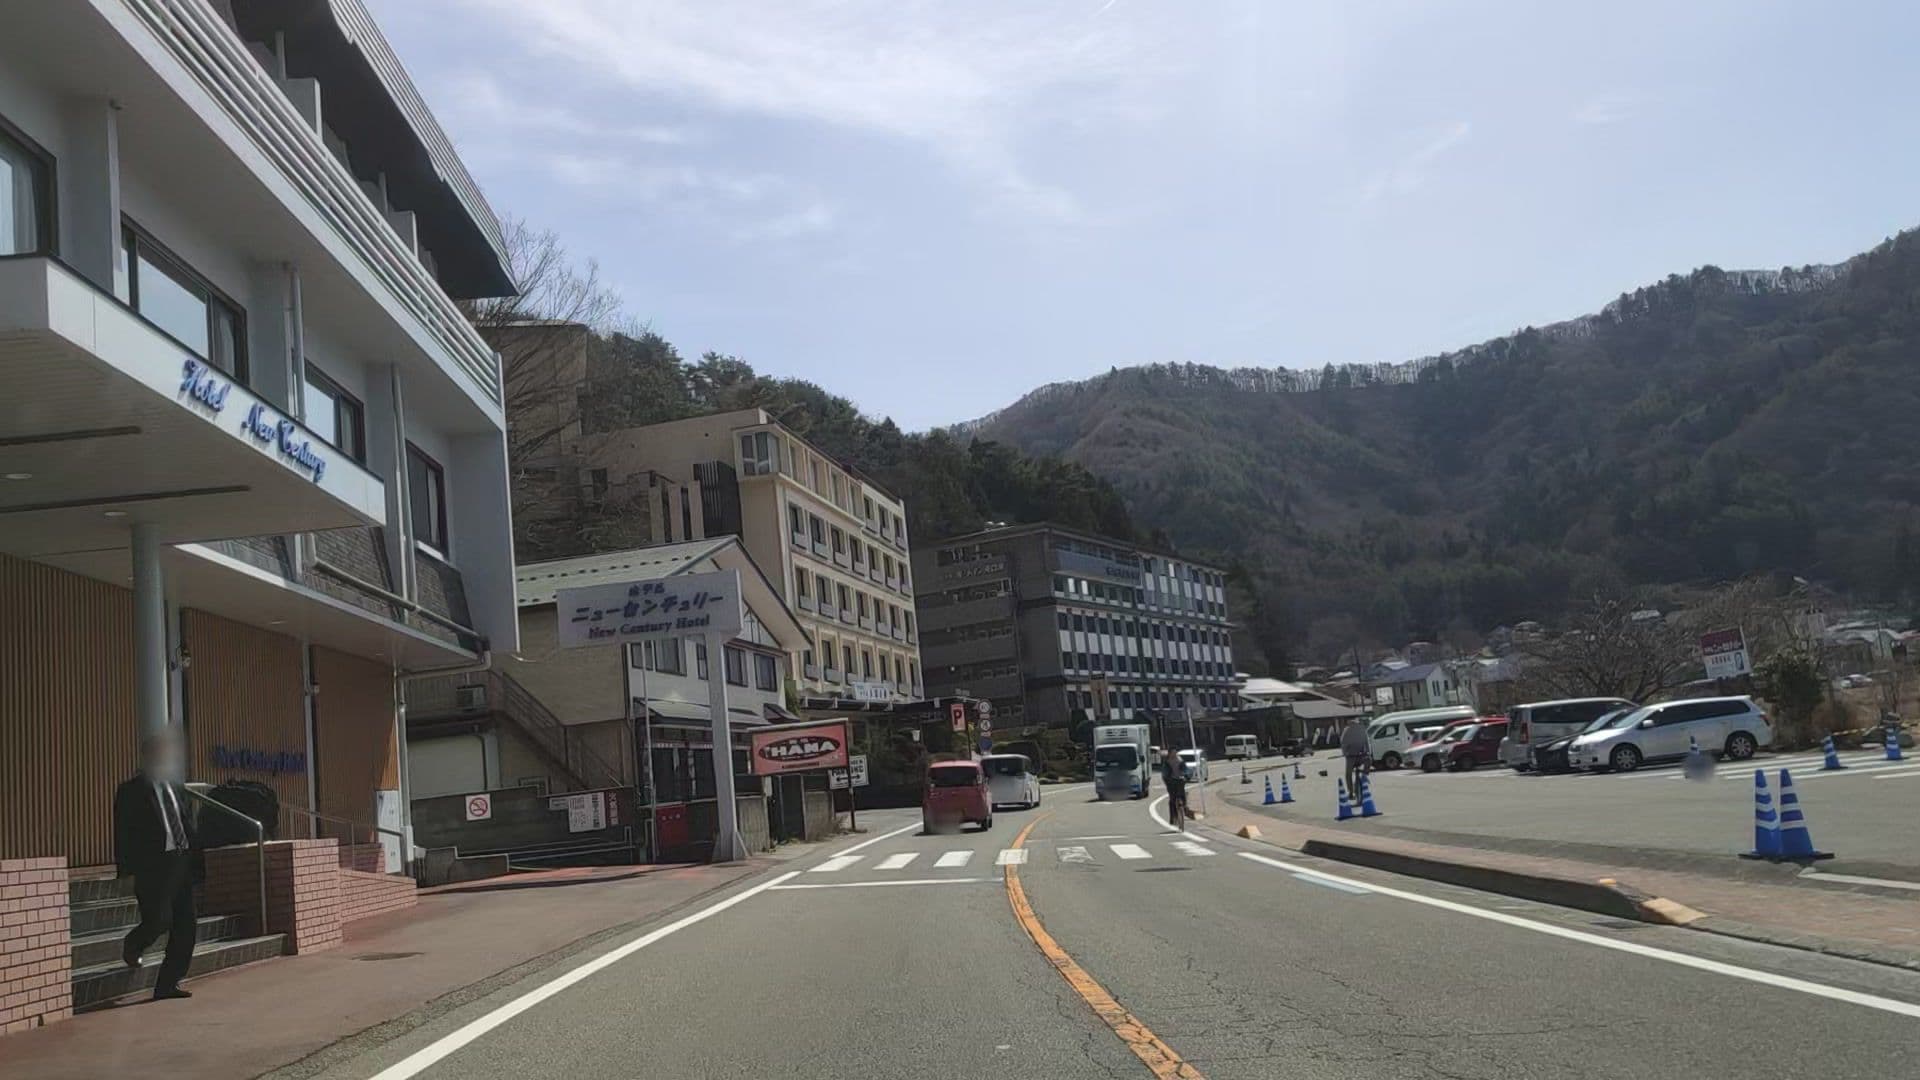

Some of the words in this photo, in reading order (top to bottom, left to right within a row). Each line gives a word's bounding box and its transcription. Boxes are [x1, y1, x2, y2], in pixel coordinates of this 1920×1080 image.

[180, 358, 232, 412] Hotel
[241, 402, 276, 443] New
[276, 418, 327, 484] Century
[629, 582, 665, 597] ホテル
[572, 592, 724, 623] ニューセンチュリー
[589, 627, 616, 639] New
[621, 622, 673, 635] Century
[676, 614, 711, 628] Hotel
[953, 708, 962, 726] P
